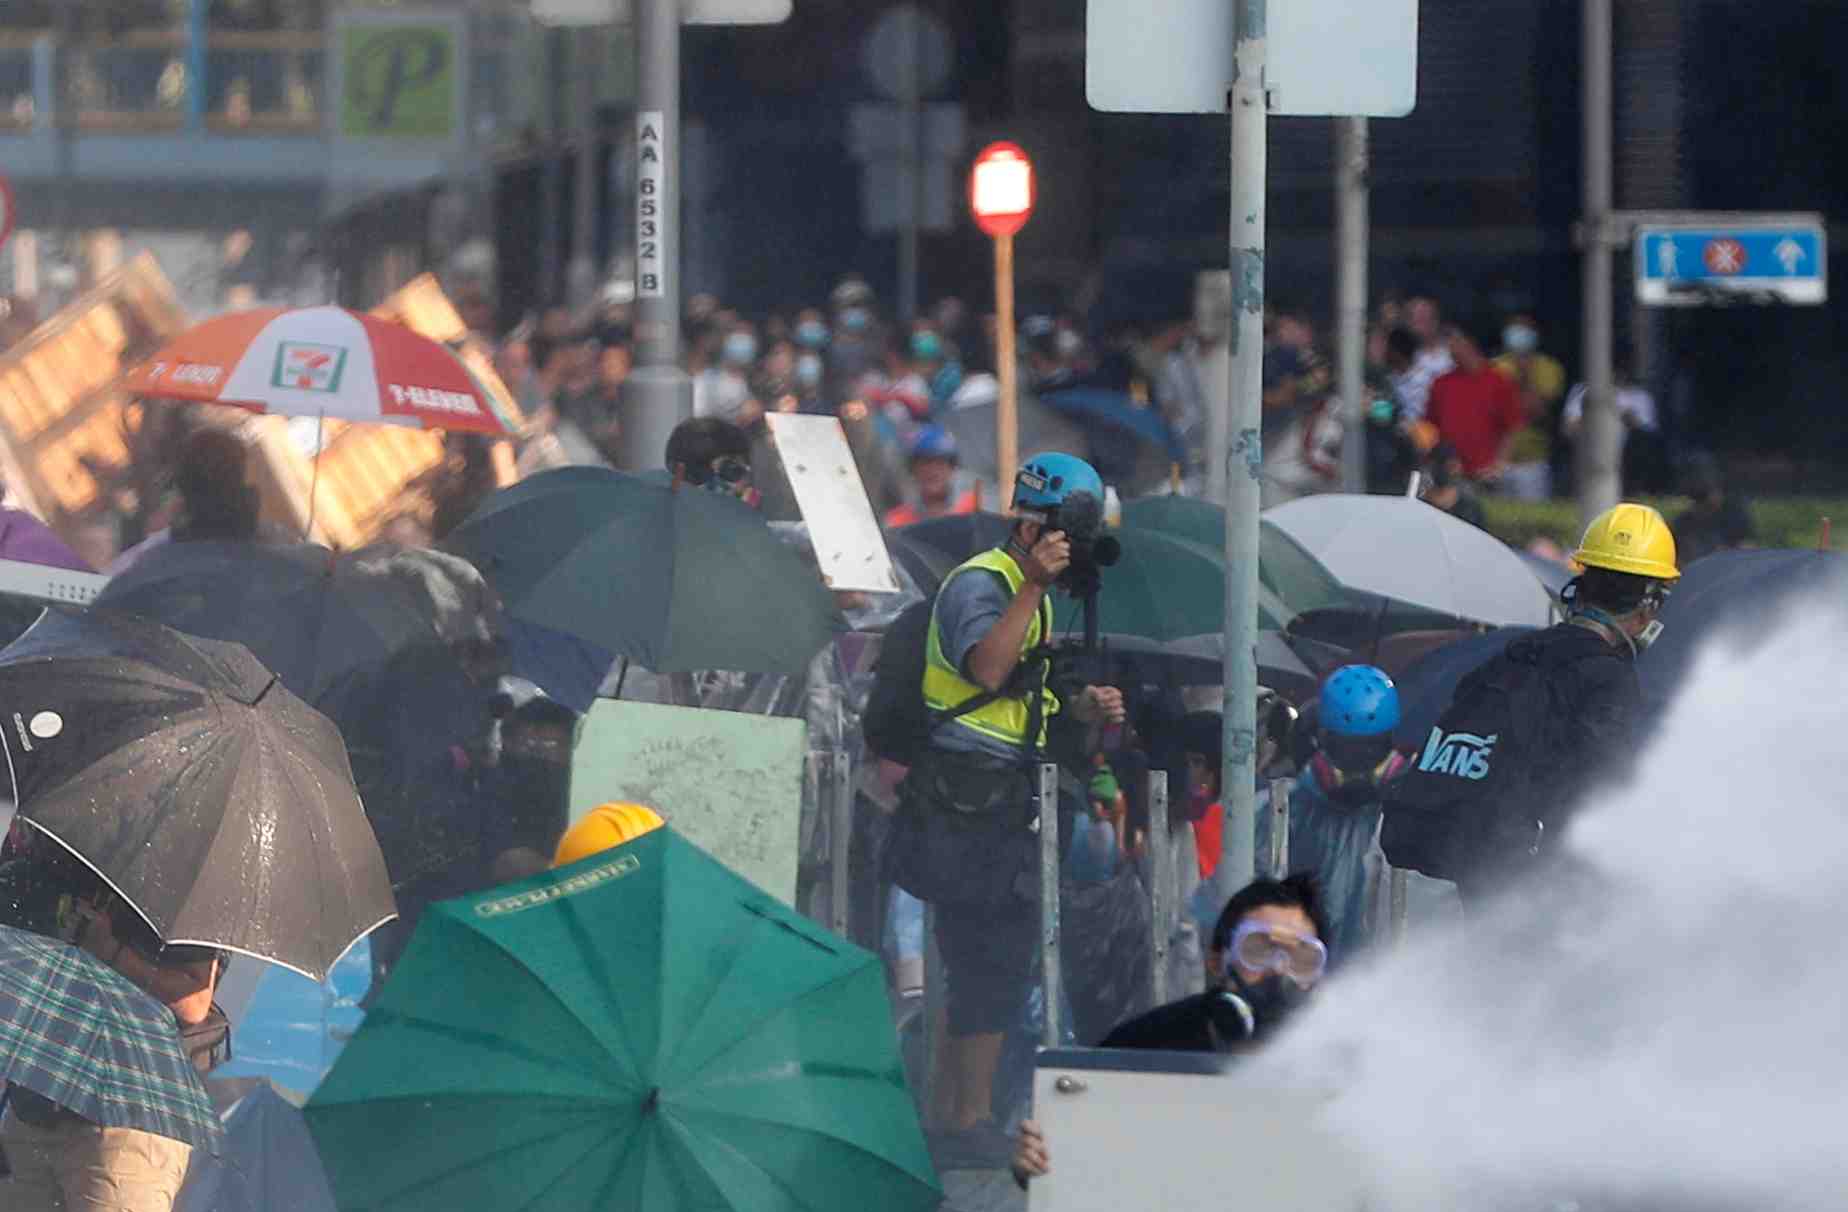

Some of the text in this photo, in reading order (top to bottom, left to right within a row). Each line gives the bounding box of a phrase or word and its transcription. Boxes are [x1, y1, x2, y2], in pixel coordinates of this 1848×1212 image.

[640, 124, 659, 291] AA 6532 B
[1418, 725, 1497, 780] VANS
